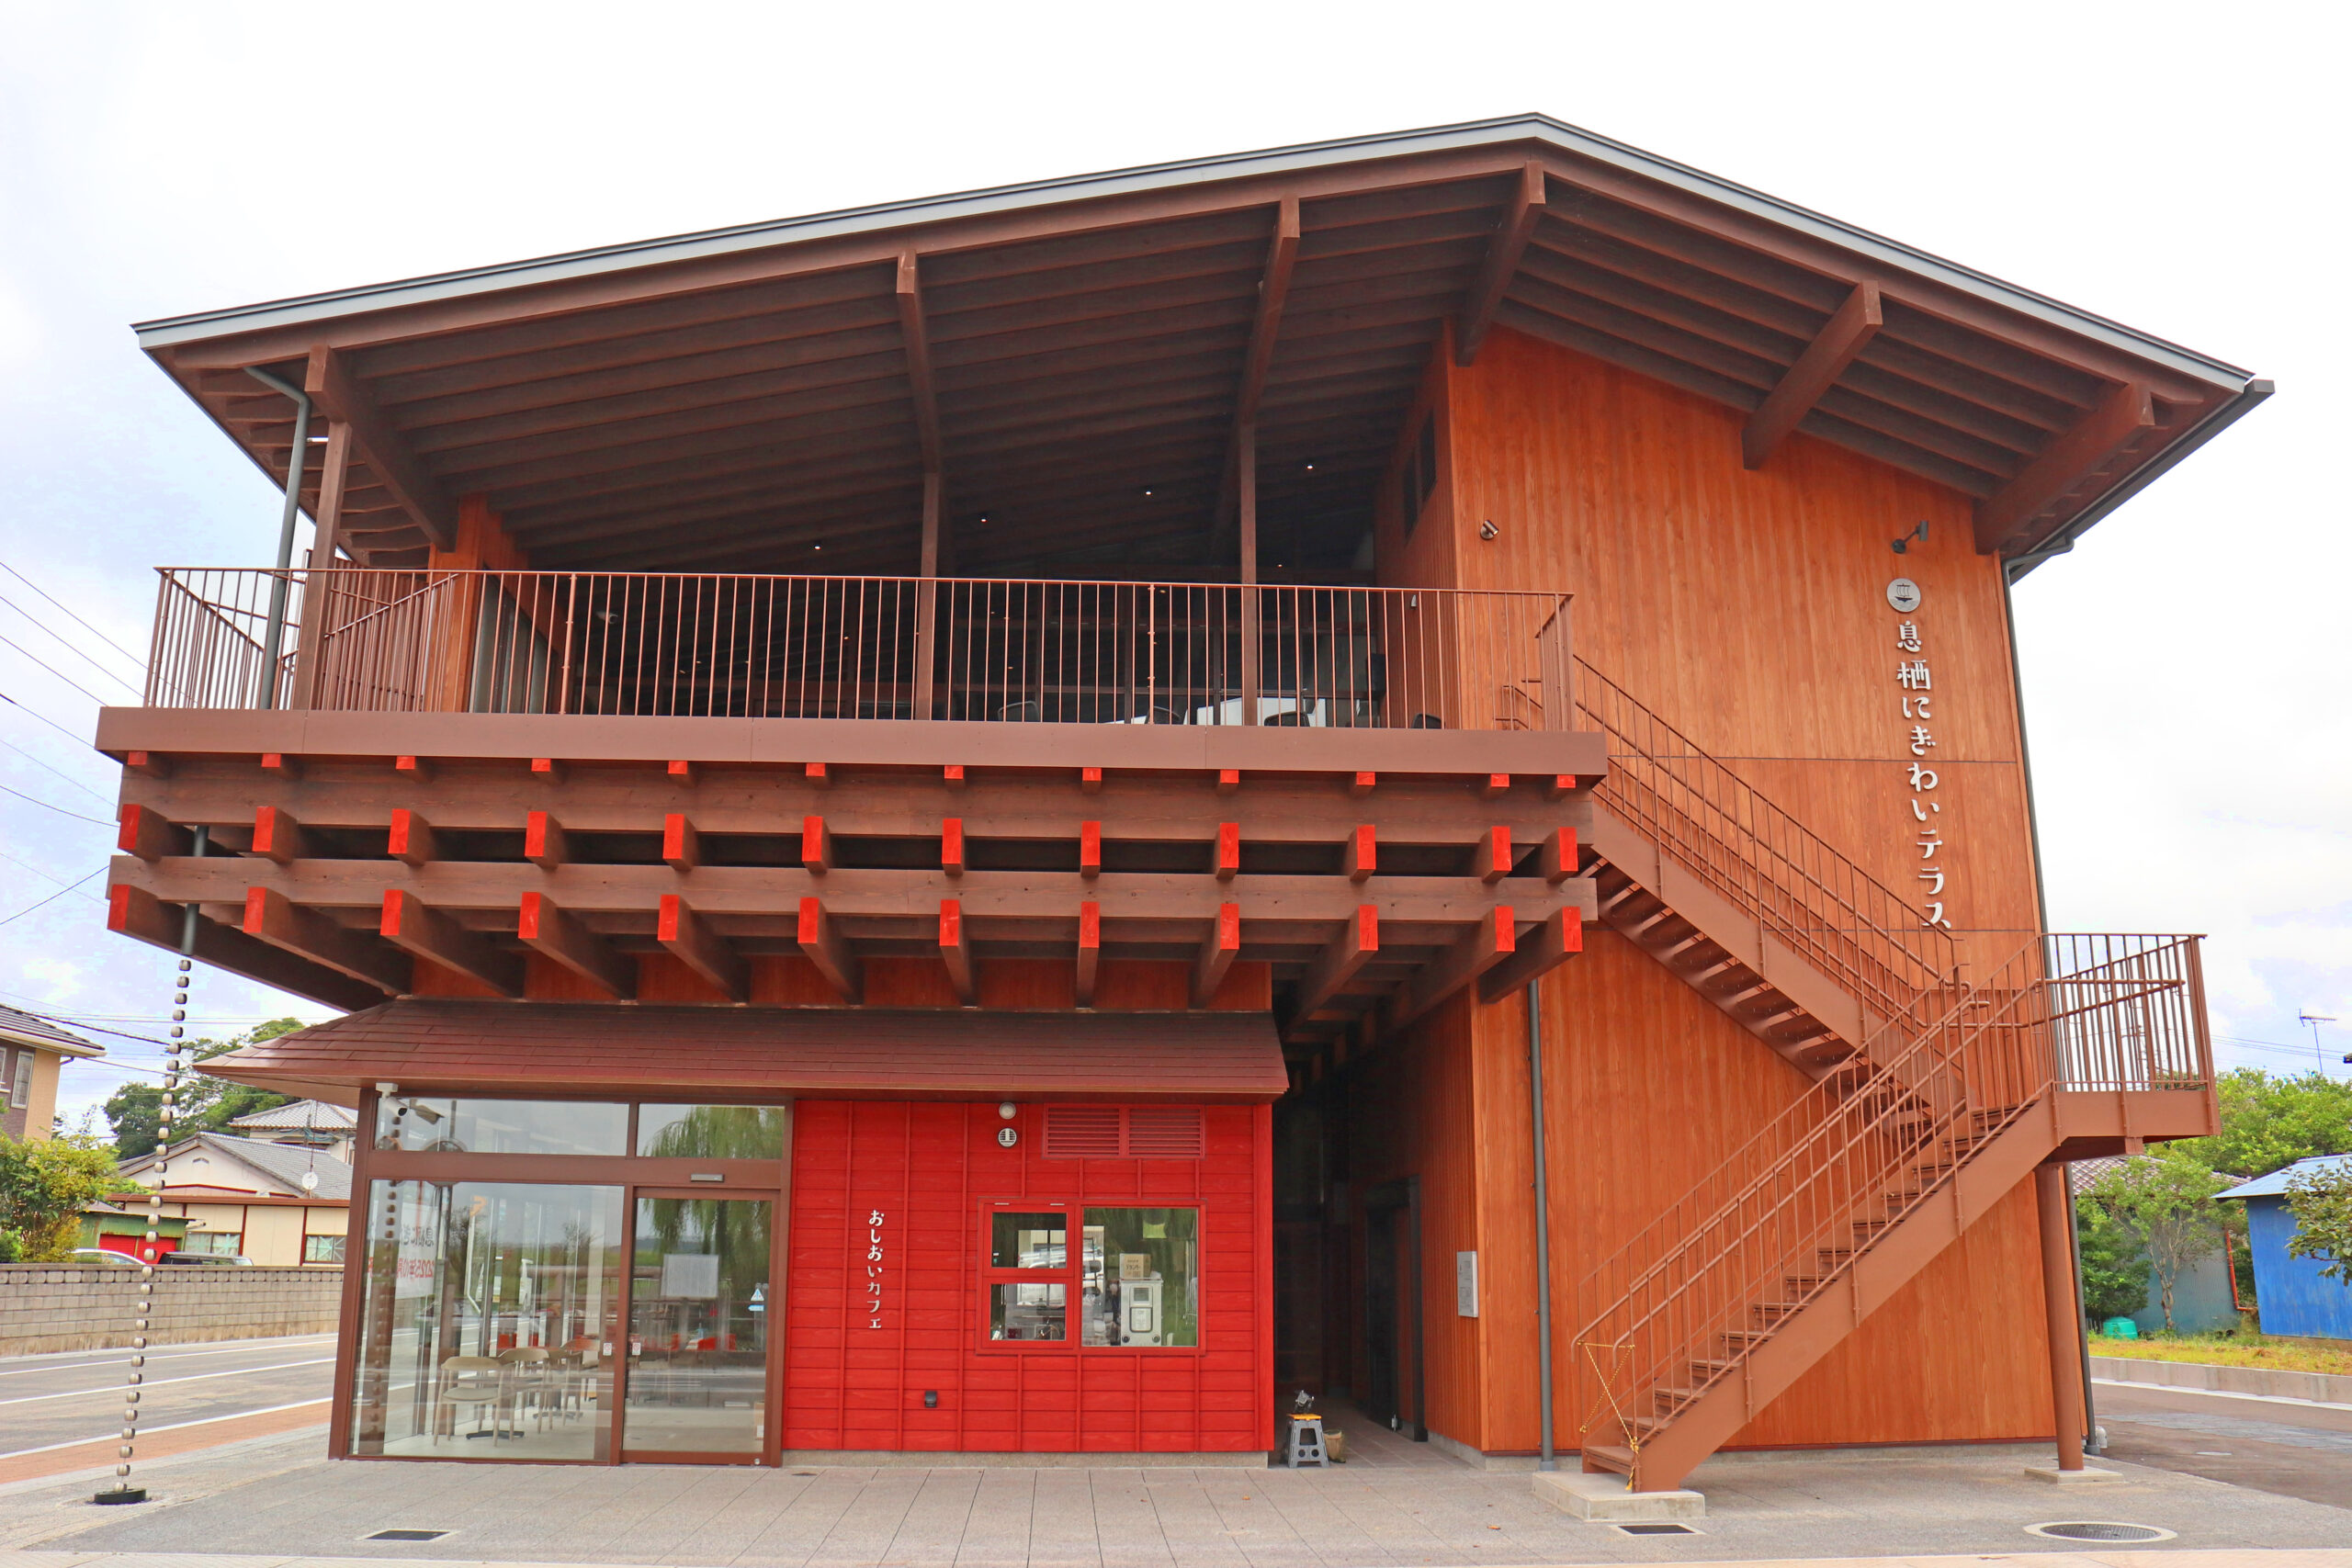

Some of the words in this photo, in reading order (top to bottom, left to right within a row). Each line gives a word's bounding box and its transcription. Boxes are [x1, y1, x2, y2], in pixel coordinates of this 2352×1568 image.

[1896, 620, 1951, 929] 息栖にぎわいテラス
